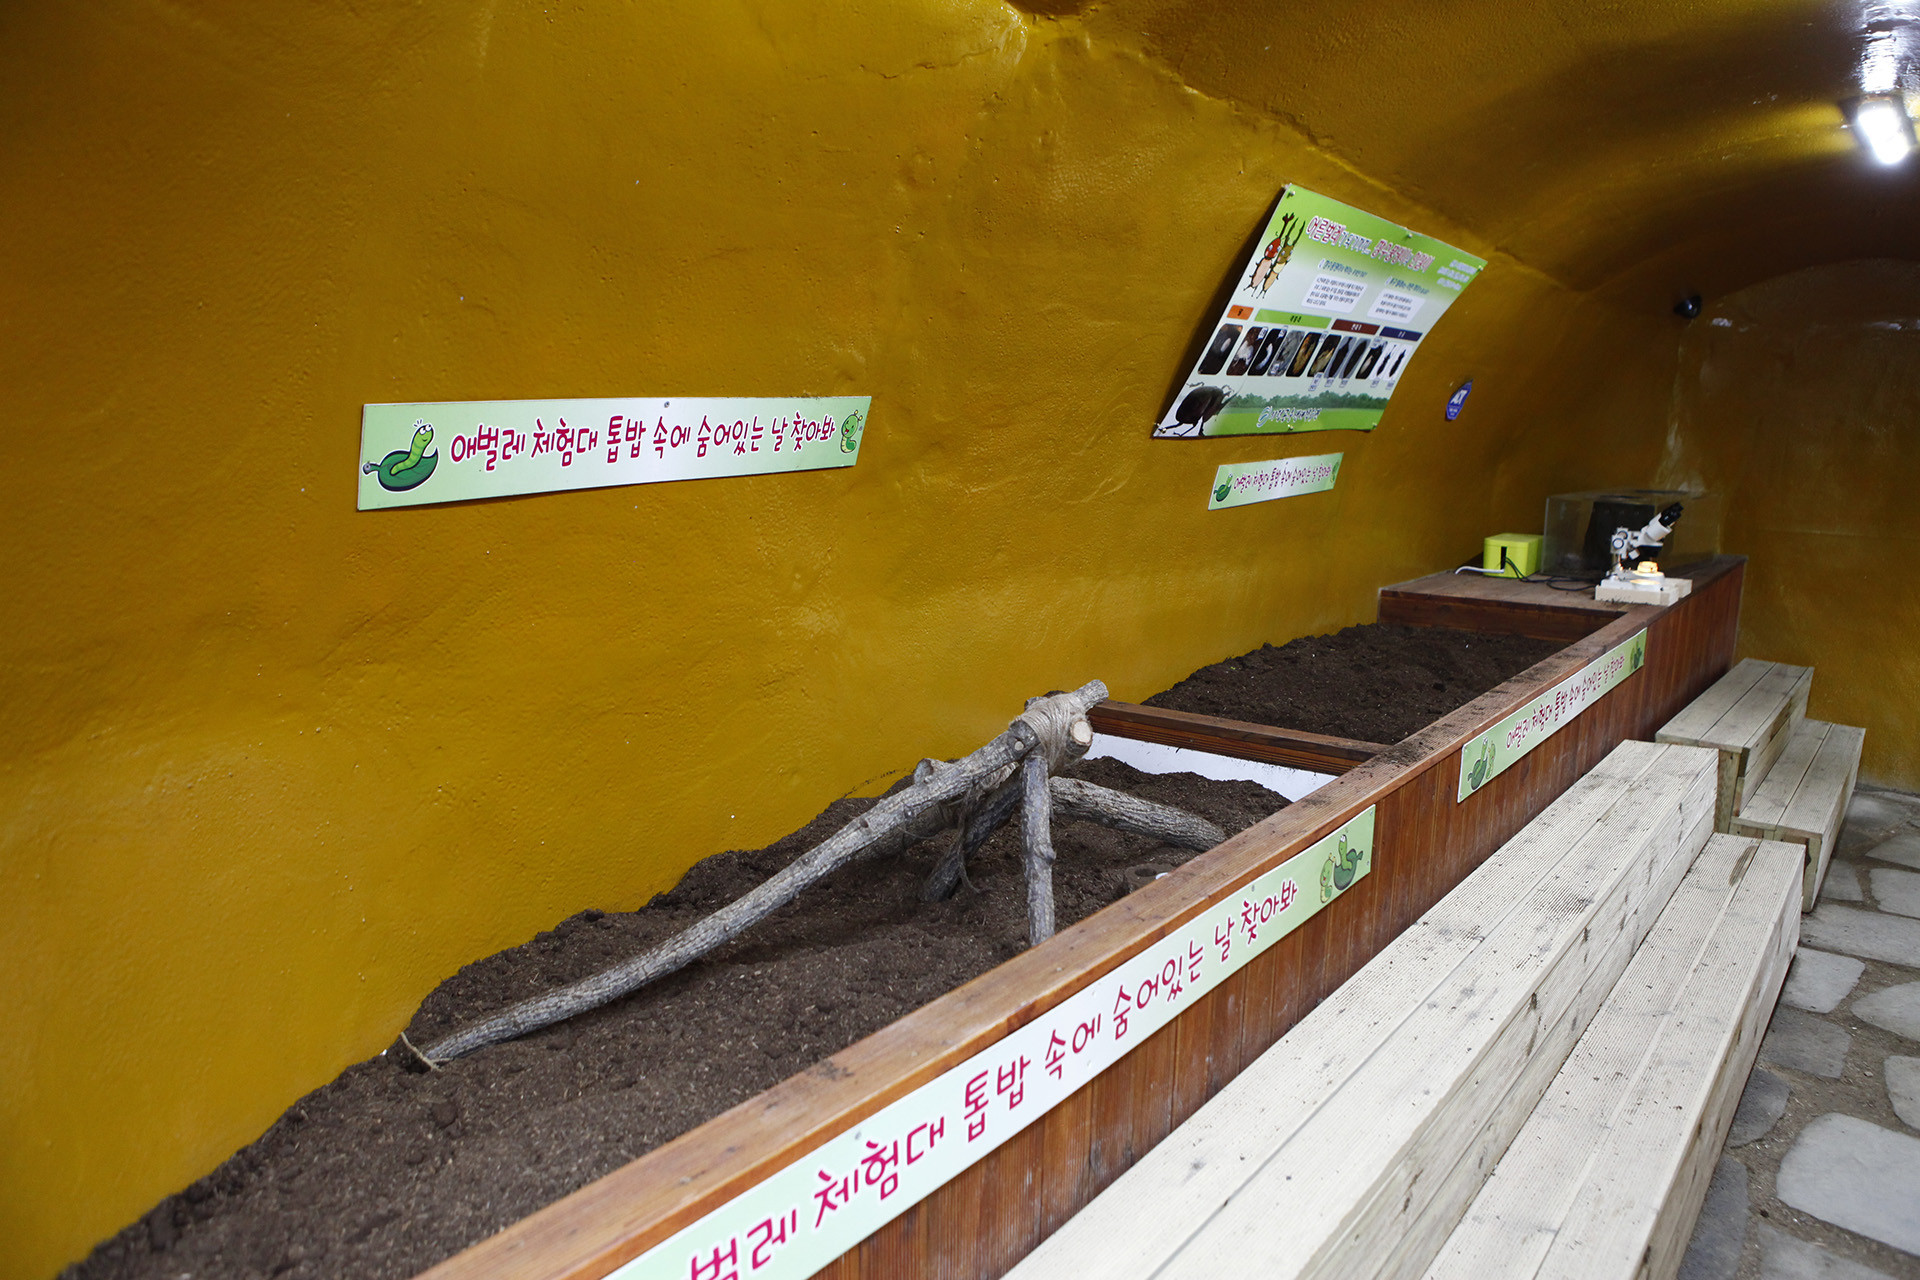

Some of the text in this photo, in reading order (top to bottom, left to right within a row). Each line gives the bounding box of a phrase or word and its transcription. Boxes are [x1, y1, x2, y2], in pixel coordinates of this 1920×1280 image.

[452, 411, 836, 471] 애벌레 체험대 톱밥 속에 숨어있는 날 찾아봐
[1506, 718, 1530, 749] 애벌레
[1530, 704, 1553, 732] 체험대
[1555, 691, 1568, 721] 톱밥
[1569, 684, 1580, 709] 속에
[814, 1116, 945, 1229] 체험대
[964, 1053, 1031, 1143] 톱밥
[1045, 1013, 1101, 1080] 속에
[1113, 939, 1204, 1041] 숨어있는
[1214, 917, 1235, 963] 날
[1240, 880, 1298, 945] 찾아봐
